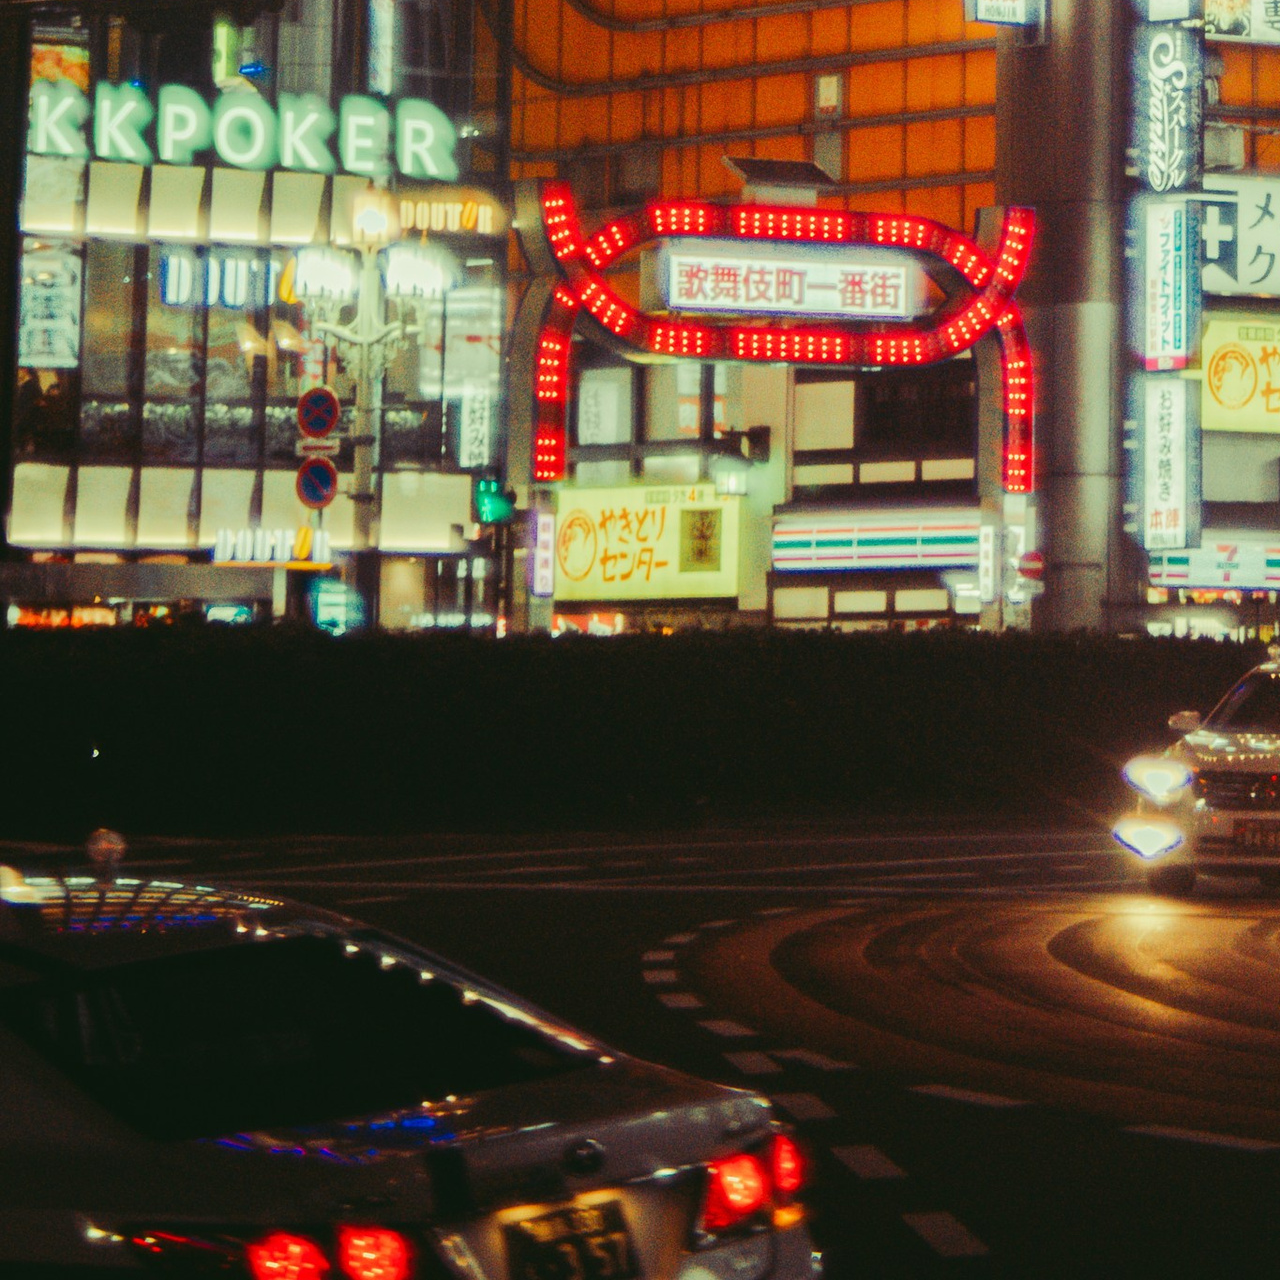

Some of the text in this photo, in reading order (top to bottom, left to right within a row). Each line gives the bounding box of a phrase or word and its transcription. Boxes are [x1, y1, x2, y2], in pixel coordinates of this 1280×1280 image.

[32, 94, 440, 176] KKPOKER
[677, 262, 901, 310] 歌舞伎町一番街
[600, 506, 667, 543] やきとり
[1149, 507, 1180, 531] 本陣
[600, 547, 669, 582] センター
